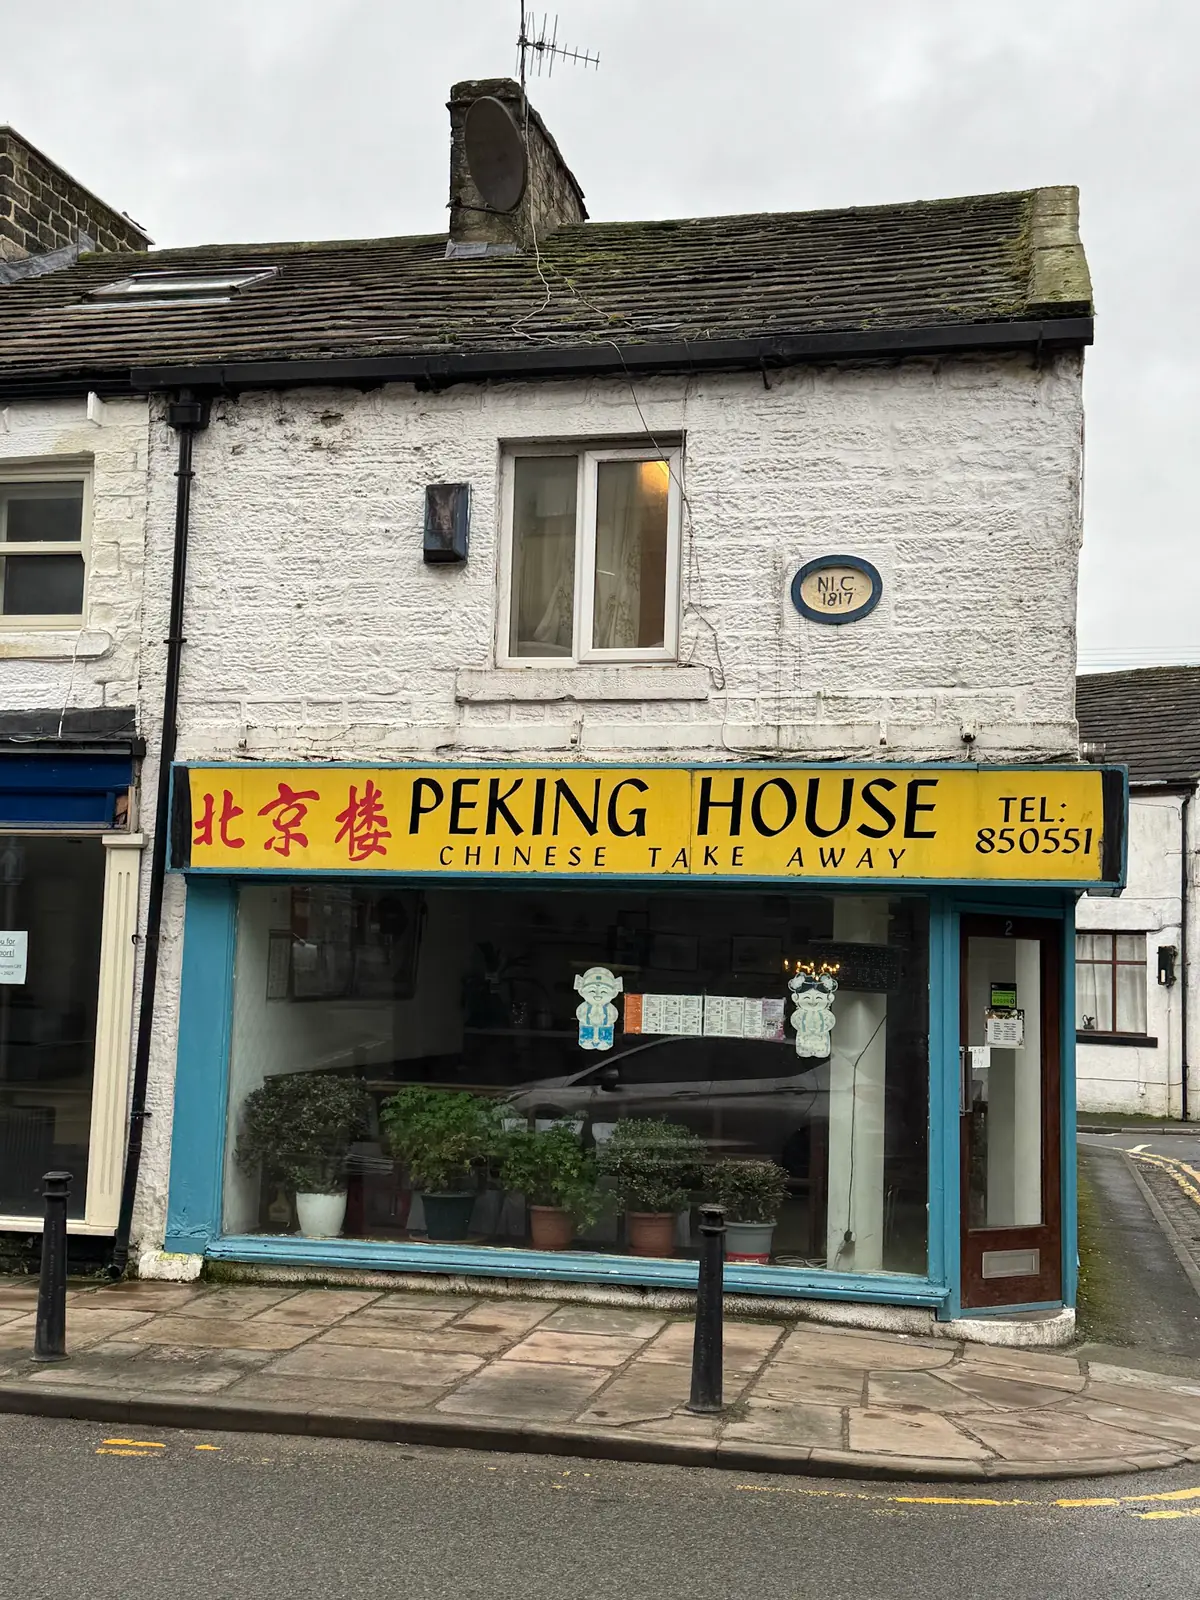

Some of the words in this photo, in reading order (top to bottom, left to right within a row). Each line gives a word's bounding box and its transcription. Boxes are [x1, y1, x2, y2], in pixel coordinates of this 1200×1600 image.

[822, 592, 854, 606] 1817
[193, 779, 391, 862] 北京楼
[409, 777, 650, 838] PEKING
[696, 776, 940, 839] HOUSE
[998, 796, 1068, 823] TEL:
[975, 827, 1093, 855] 850551
[440, 845, 606, 867] CHINESE
[648, 846, 744, 868] TAKE
[787, 847, 906, 869] AWAY
[1004, 920, 1014, 936] 2
